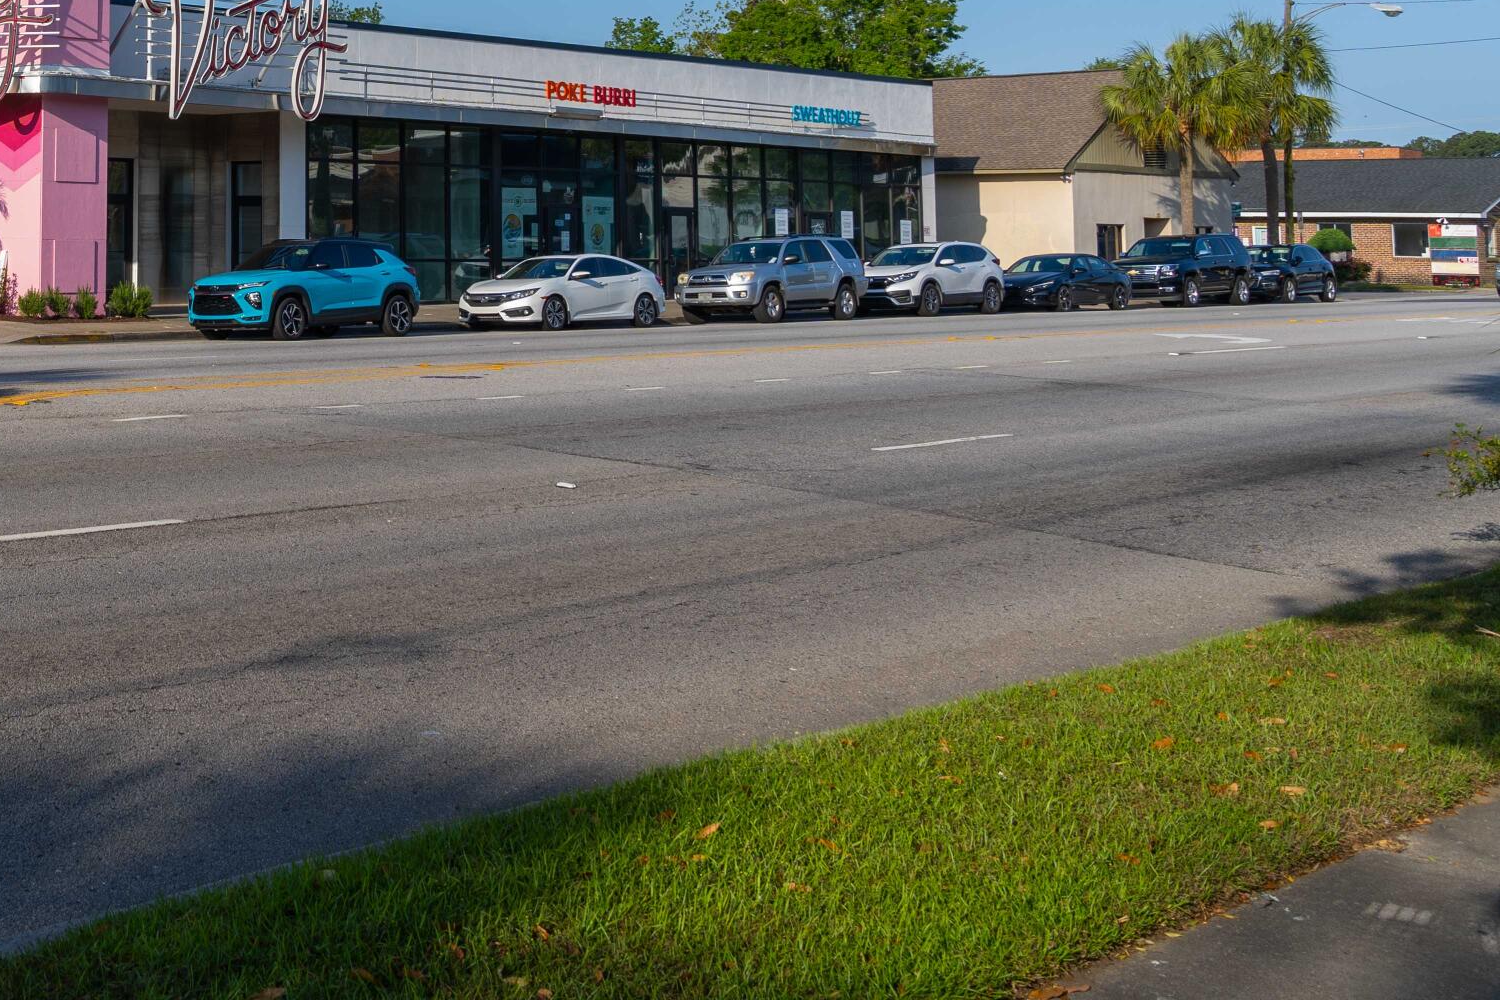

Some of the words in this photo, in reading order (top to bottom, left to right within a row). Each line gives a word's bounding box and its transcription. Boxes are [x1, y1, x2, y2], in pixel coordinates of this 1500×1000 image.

[546, 80, 587, 103] POKE
[593, 85, 637, 107] BURRI
[793, 104, 862, 127] SWEATHOUZ
